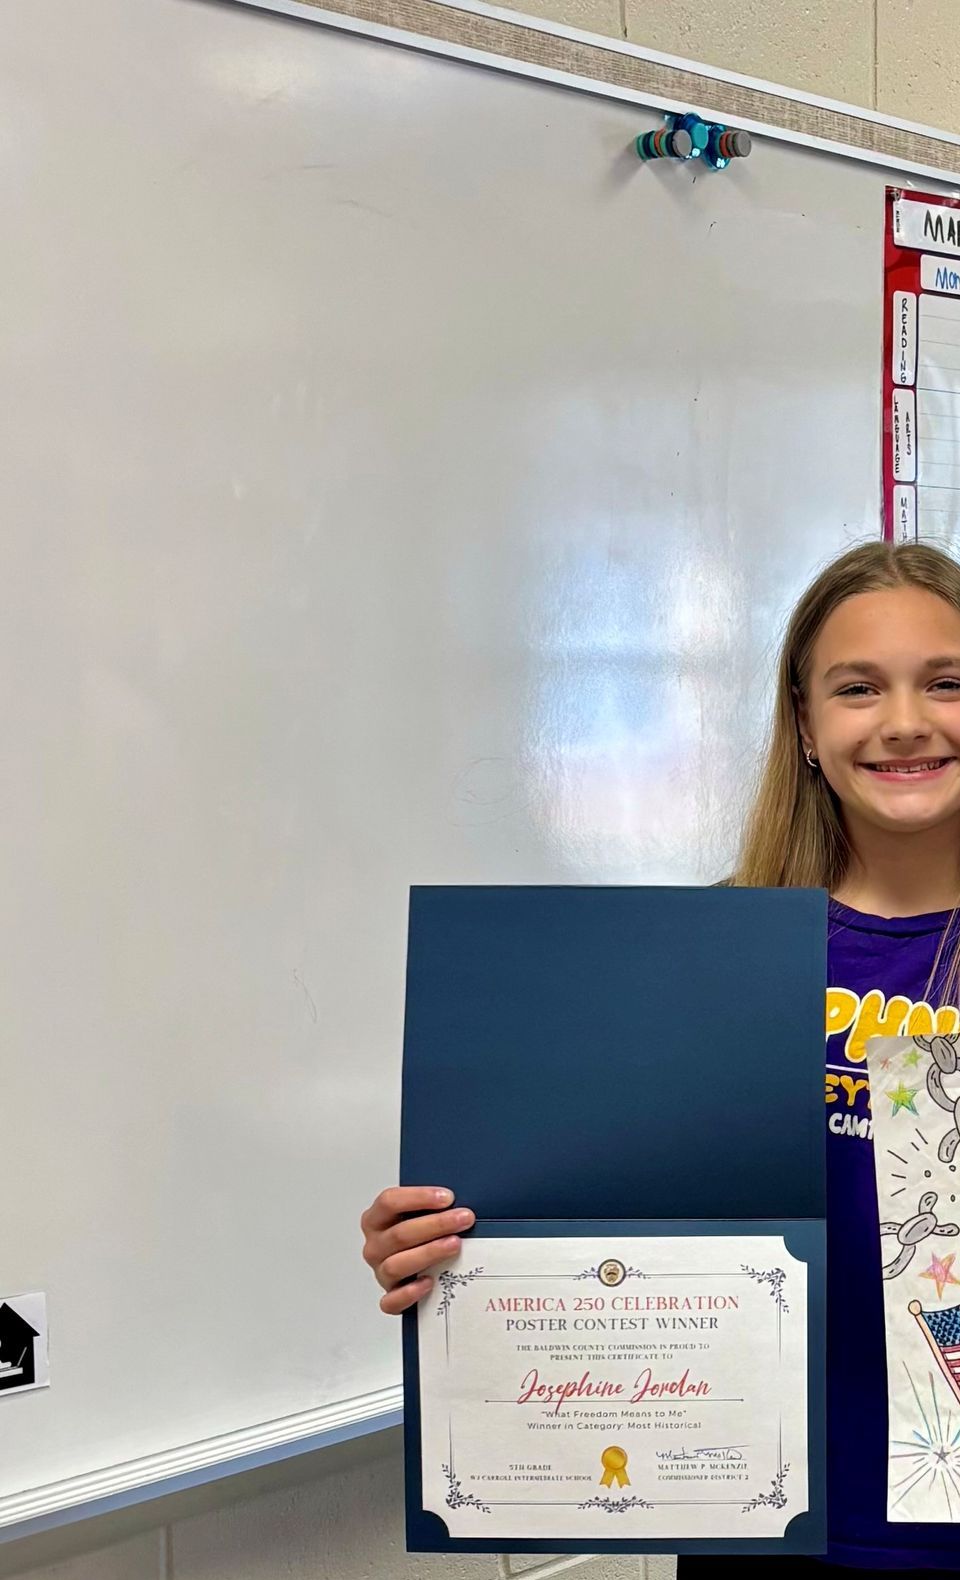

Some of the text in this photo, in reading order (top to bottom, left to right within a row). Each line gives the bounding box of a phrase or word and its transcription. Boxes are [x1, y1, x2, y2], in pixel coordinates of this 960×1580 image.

[900, 298, 908, 383] READING
[485, 1295, 739, 1312] AMERICA 250 CELEBRATION
[506, 1317, 718, 1331] POSTER CONTEST WINNER
[517, 1367, 712, 1415] Josephine Jordan
[574, 1410, 618, 1418] Freedom
[621, 1410, 652, 1418] Means
[655, 1410, 666, 1418] to
[527, 1422, 561, 1430] Winner
[565, 1422, 573, 1430] in
[654, 1421, 702, 1429] Historical
